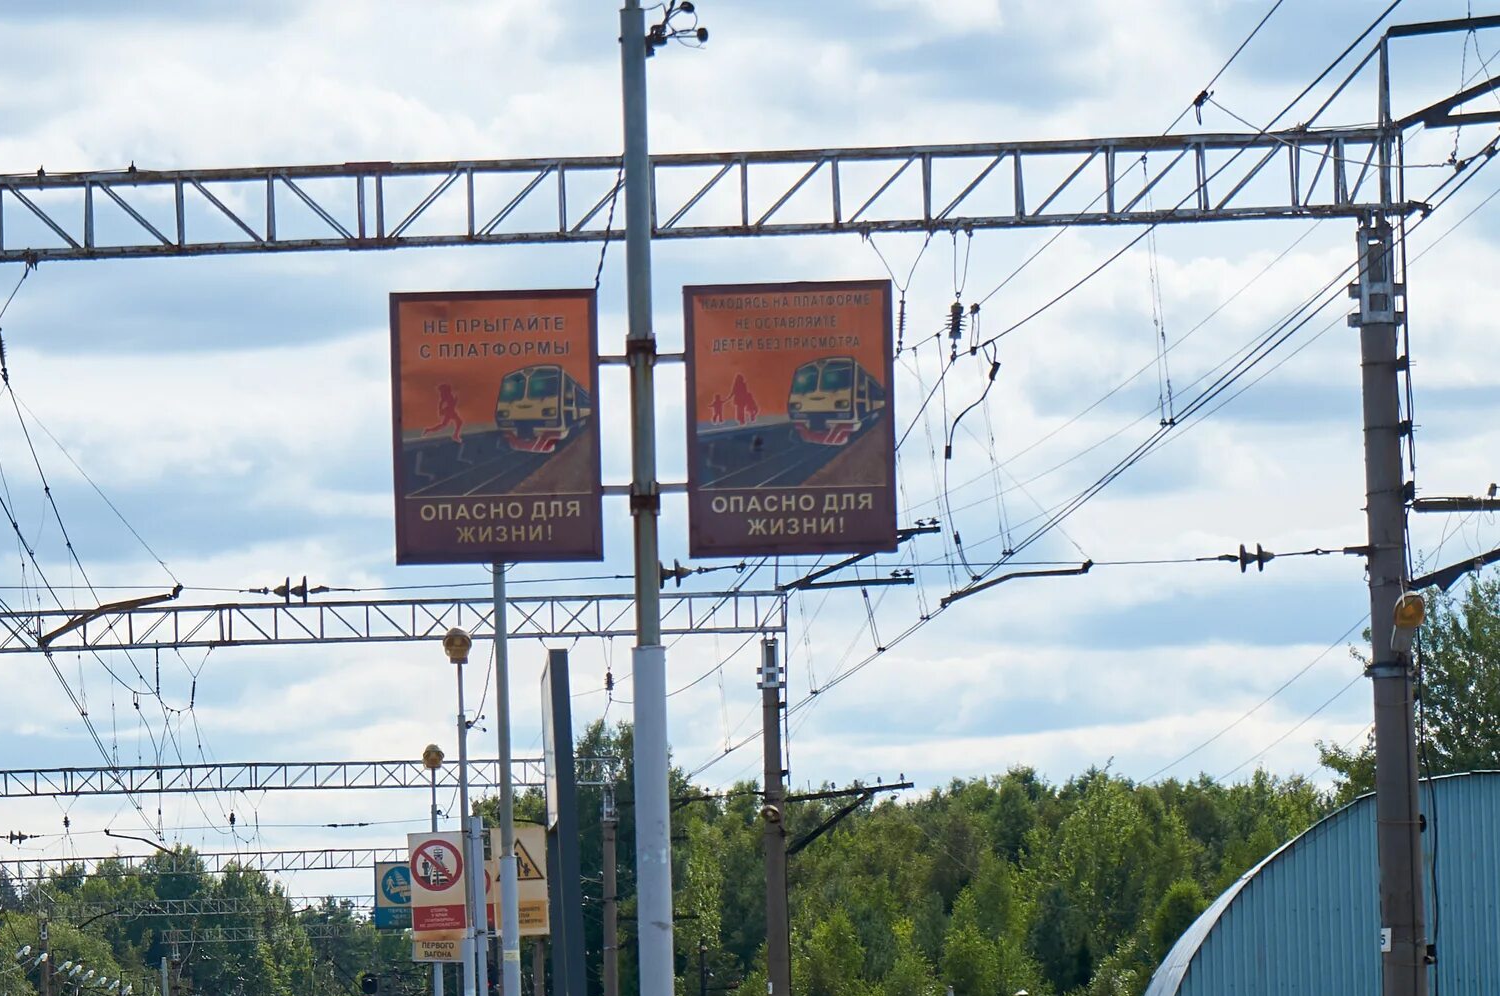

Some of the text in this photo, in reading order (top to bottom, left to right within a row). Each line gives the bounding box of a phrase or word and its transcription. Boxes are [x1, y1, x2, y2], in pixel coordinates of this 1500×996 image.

[701, 294, 870, 310] НАХОДЯСЬ НА ПЛАТФОРМЕ
[423, 315, 565, 334] НЕ ПРЫГАЙТЕ
[735, 318, 749, 330] НЕ
[419, 341, 570, 359] С ПЛАТФОРМЫ
[757, 338, 780, 350] БЕЗ
[784, 336, 860, 349] ПРИСМОТРА
[420, 500, 581, 521] ОПАСНО ДЛЯ
[711, 493, 873, 514] ОПАСНО ДЛЯ
[456, 524, 552, 543] ЖИЗНИ!
[747, 516, 845, 536] ЖИЗНИ!
[421, 942, 455, 950] ПЕРВОГО
[424, 950, 452, 958] ВАГОНА
